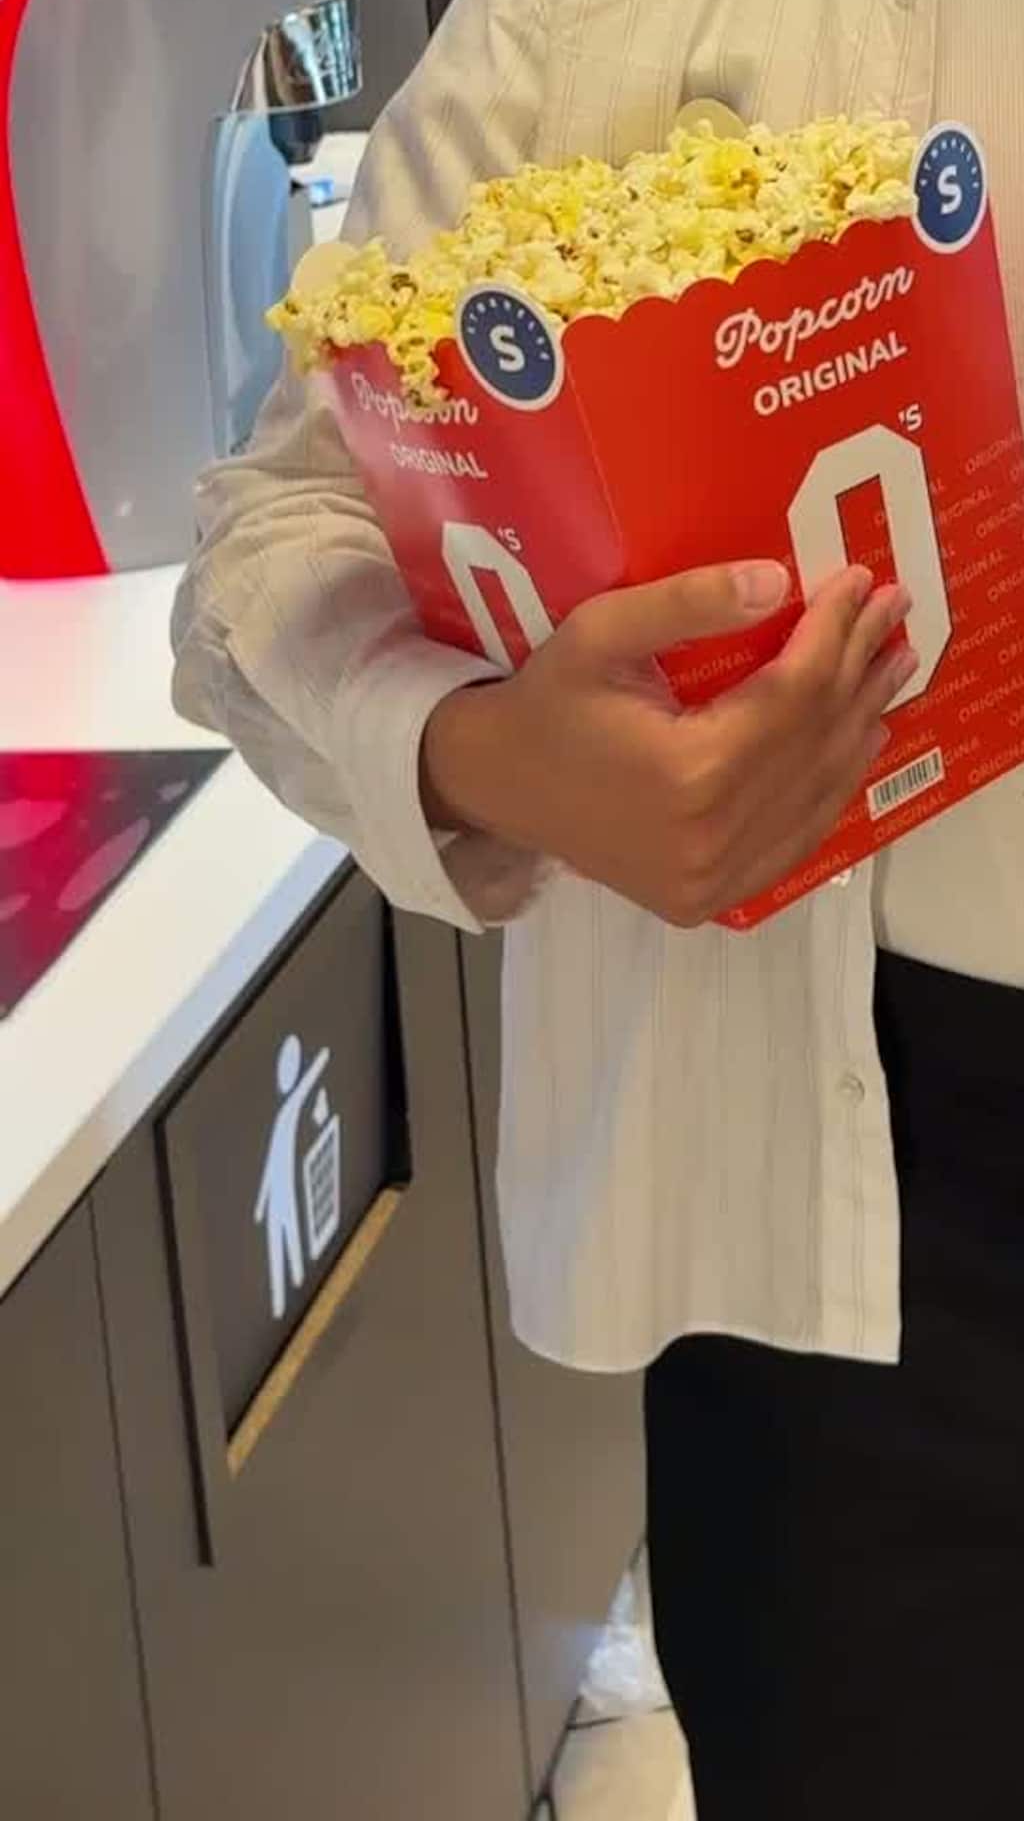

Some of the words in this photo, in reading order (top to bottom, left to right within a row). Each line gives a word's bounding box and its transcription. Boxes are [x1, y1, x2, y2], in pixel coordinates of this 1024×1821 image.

[937, 164, 963, 215] S
[714, 265, 914, 369] Popcorn
[489, 324, 526, 373] S
[753, 331, 907, 416] ORIGINAL
[390, 442, 488, 479] ORIGINAL
